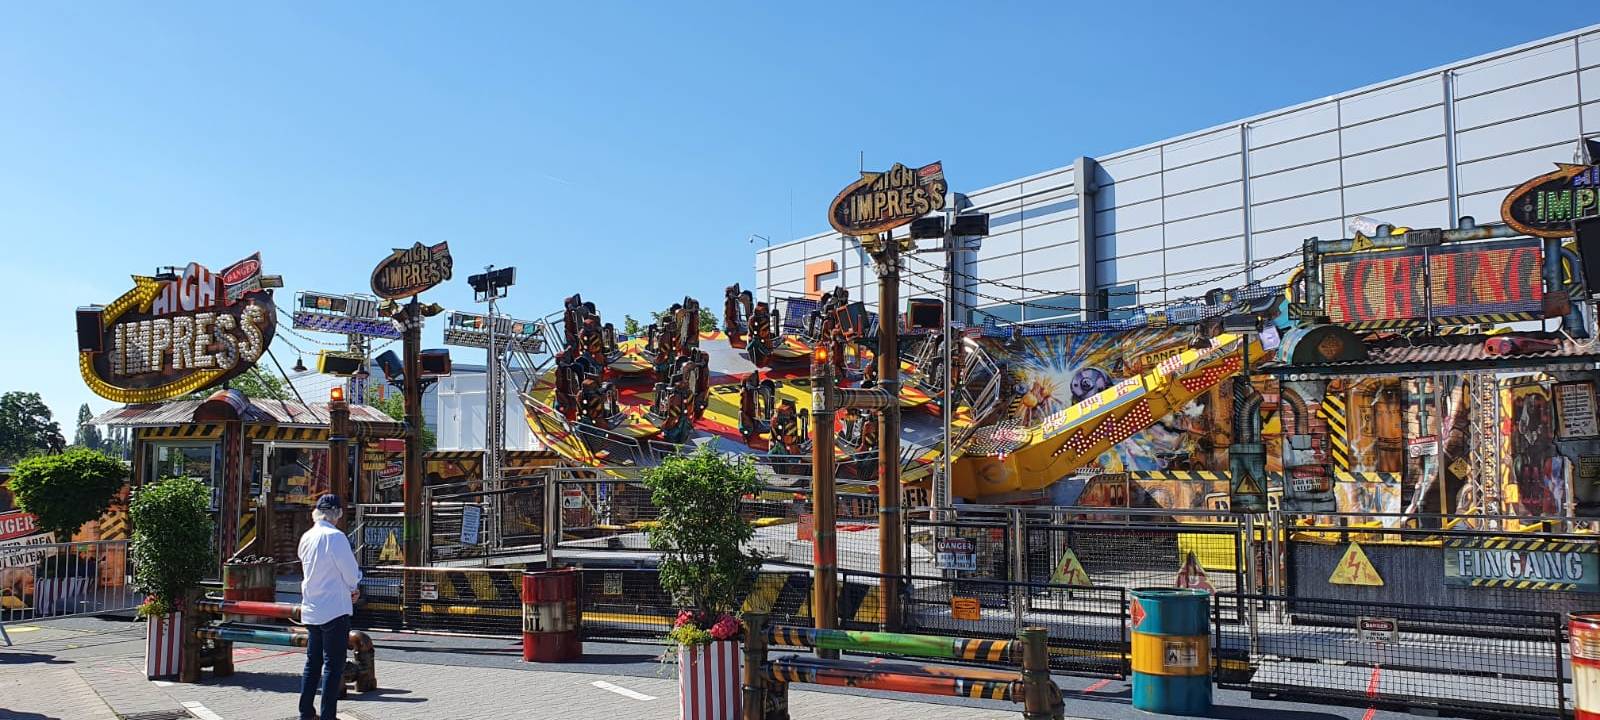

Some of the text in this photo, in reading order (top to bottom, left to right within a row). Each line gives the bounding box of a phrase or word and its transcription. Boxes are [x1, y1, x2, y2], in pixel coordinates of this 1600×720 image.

[873, 163, 914, 191] HIGH
[850, 182, 945, 222] IMPRESS
[1537, 189, 1600, 220] IMP
[400, 242, 429, 264] HIGH
[226, 262, 256, 283] DANGER
[384, 259, 450, 289] IMPRESS
[152, 262, 218, 316] HIGH
[114, 304, 264, 376] IMPRESS
[1146, 347, 1187, 364] DANGE
[940, 542, 973, 550] DANGER
[1458, 550, 1583, 580] EINGANG
